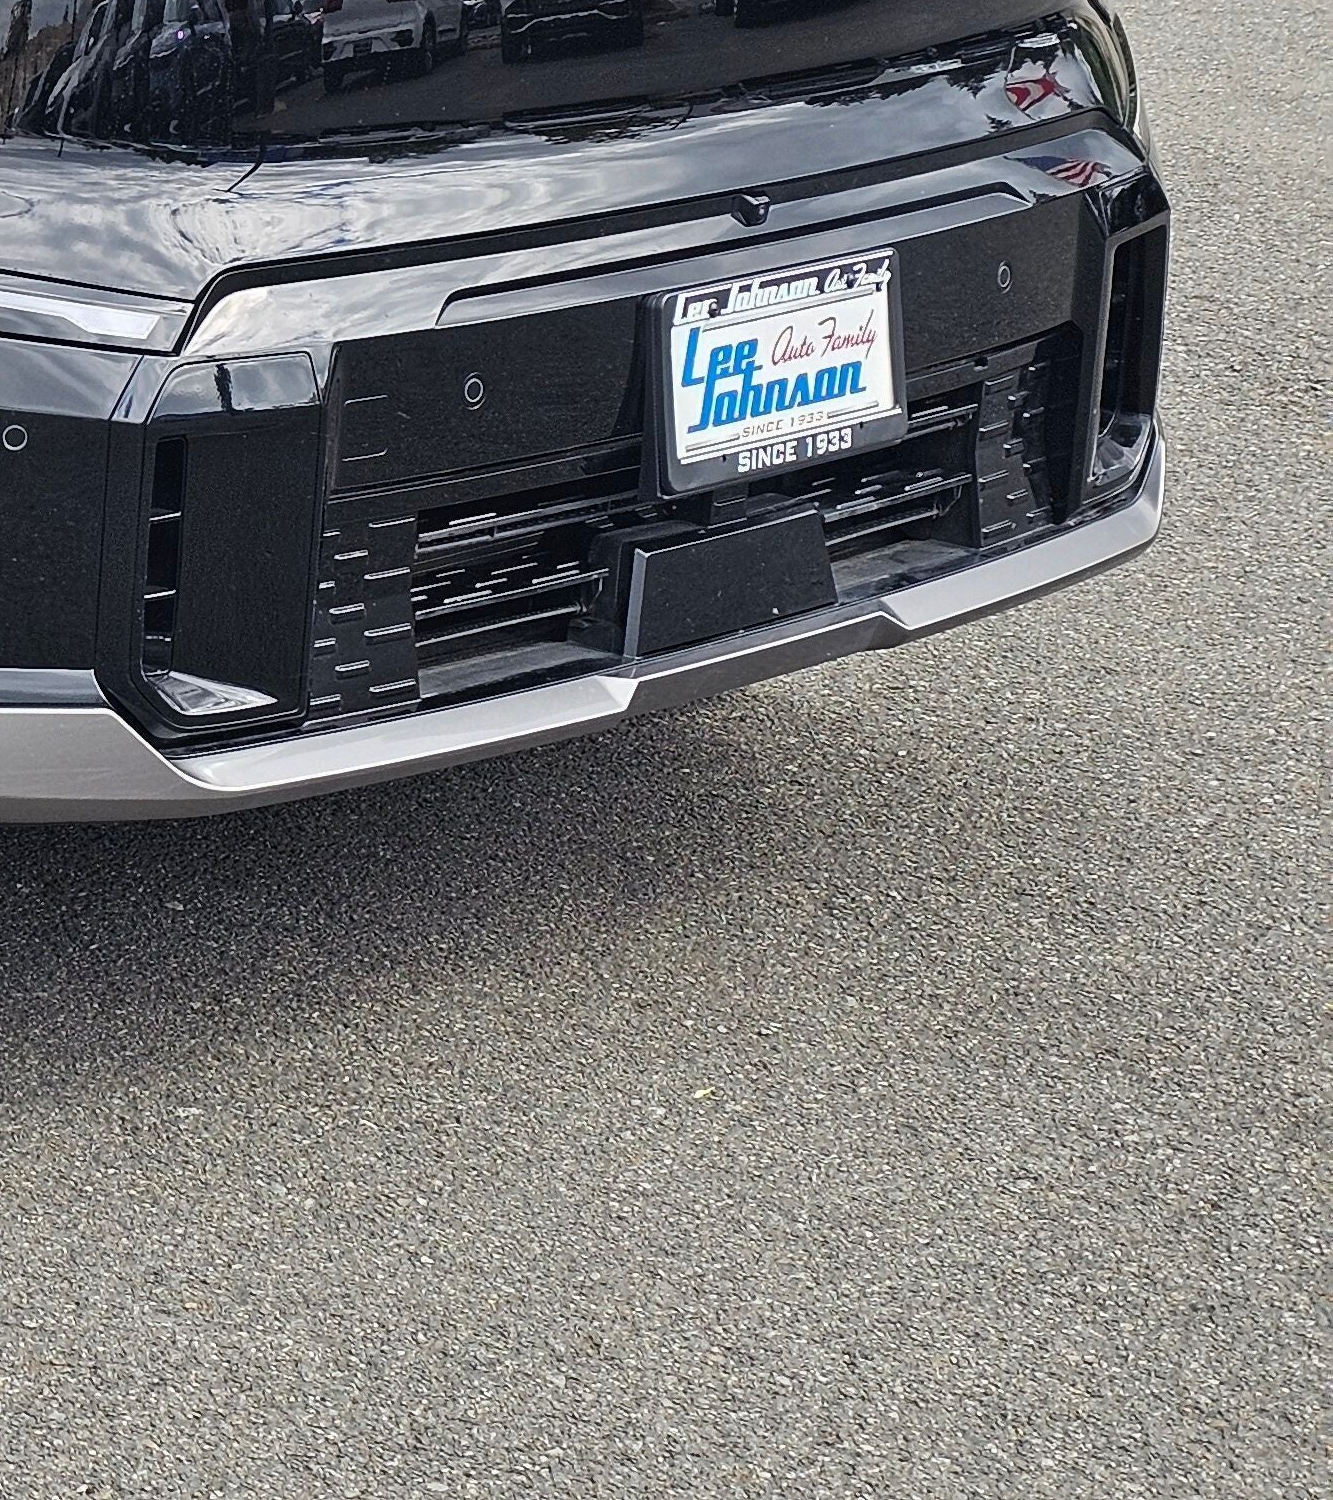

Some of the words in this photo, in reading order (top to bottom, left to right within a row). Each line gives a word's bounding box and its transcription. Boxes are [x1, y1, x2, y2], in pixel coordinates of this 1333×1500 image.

[720, 276, 821, 314] Johnson
[681, 327, 759, 388] Lee
[771, 325, 816, 367] Auto
[818, 308, 877, 360] Family
[687, 353, 867, 434] Johnson
[741, 418, 784, 438] SINCE
[790, 411, 826, 430] 1933
[737, 441, 798, 473] SINCE
[805, 427, 853, 459] 1933
